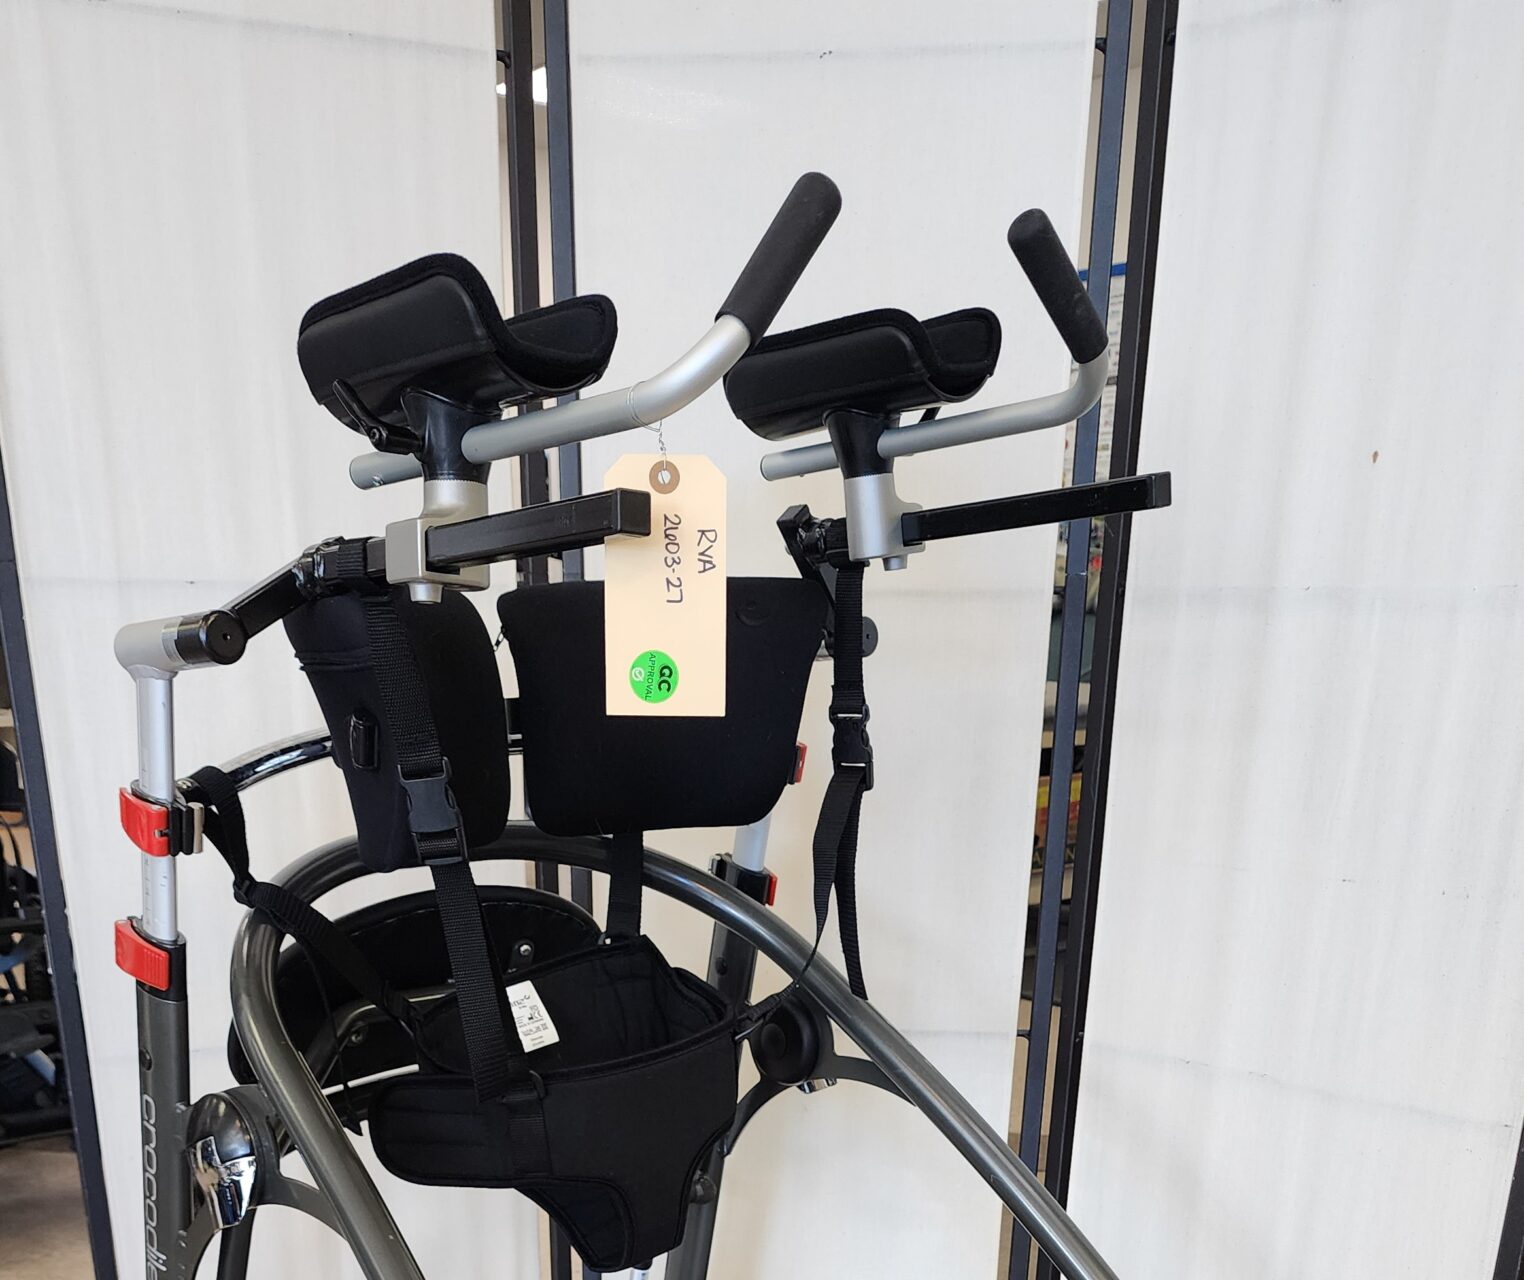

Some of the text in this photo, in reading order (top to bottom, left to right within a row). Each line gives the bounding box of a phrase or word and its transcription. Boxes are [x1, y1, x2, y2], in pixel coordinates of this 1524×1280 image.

[663, 513, 684, 604] 2603-27
[697, 528, 718, 574] RVA
[644, 652, 657, 701] APPROVAL
[657, 664, 674, 693] QC
